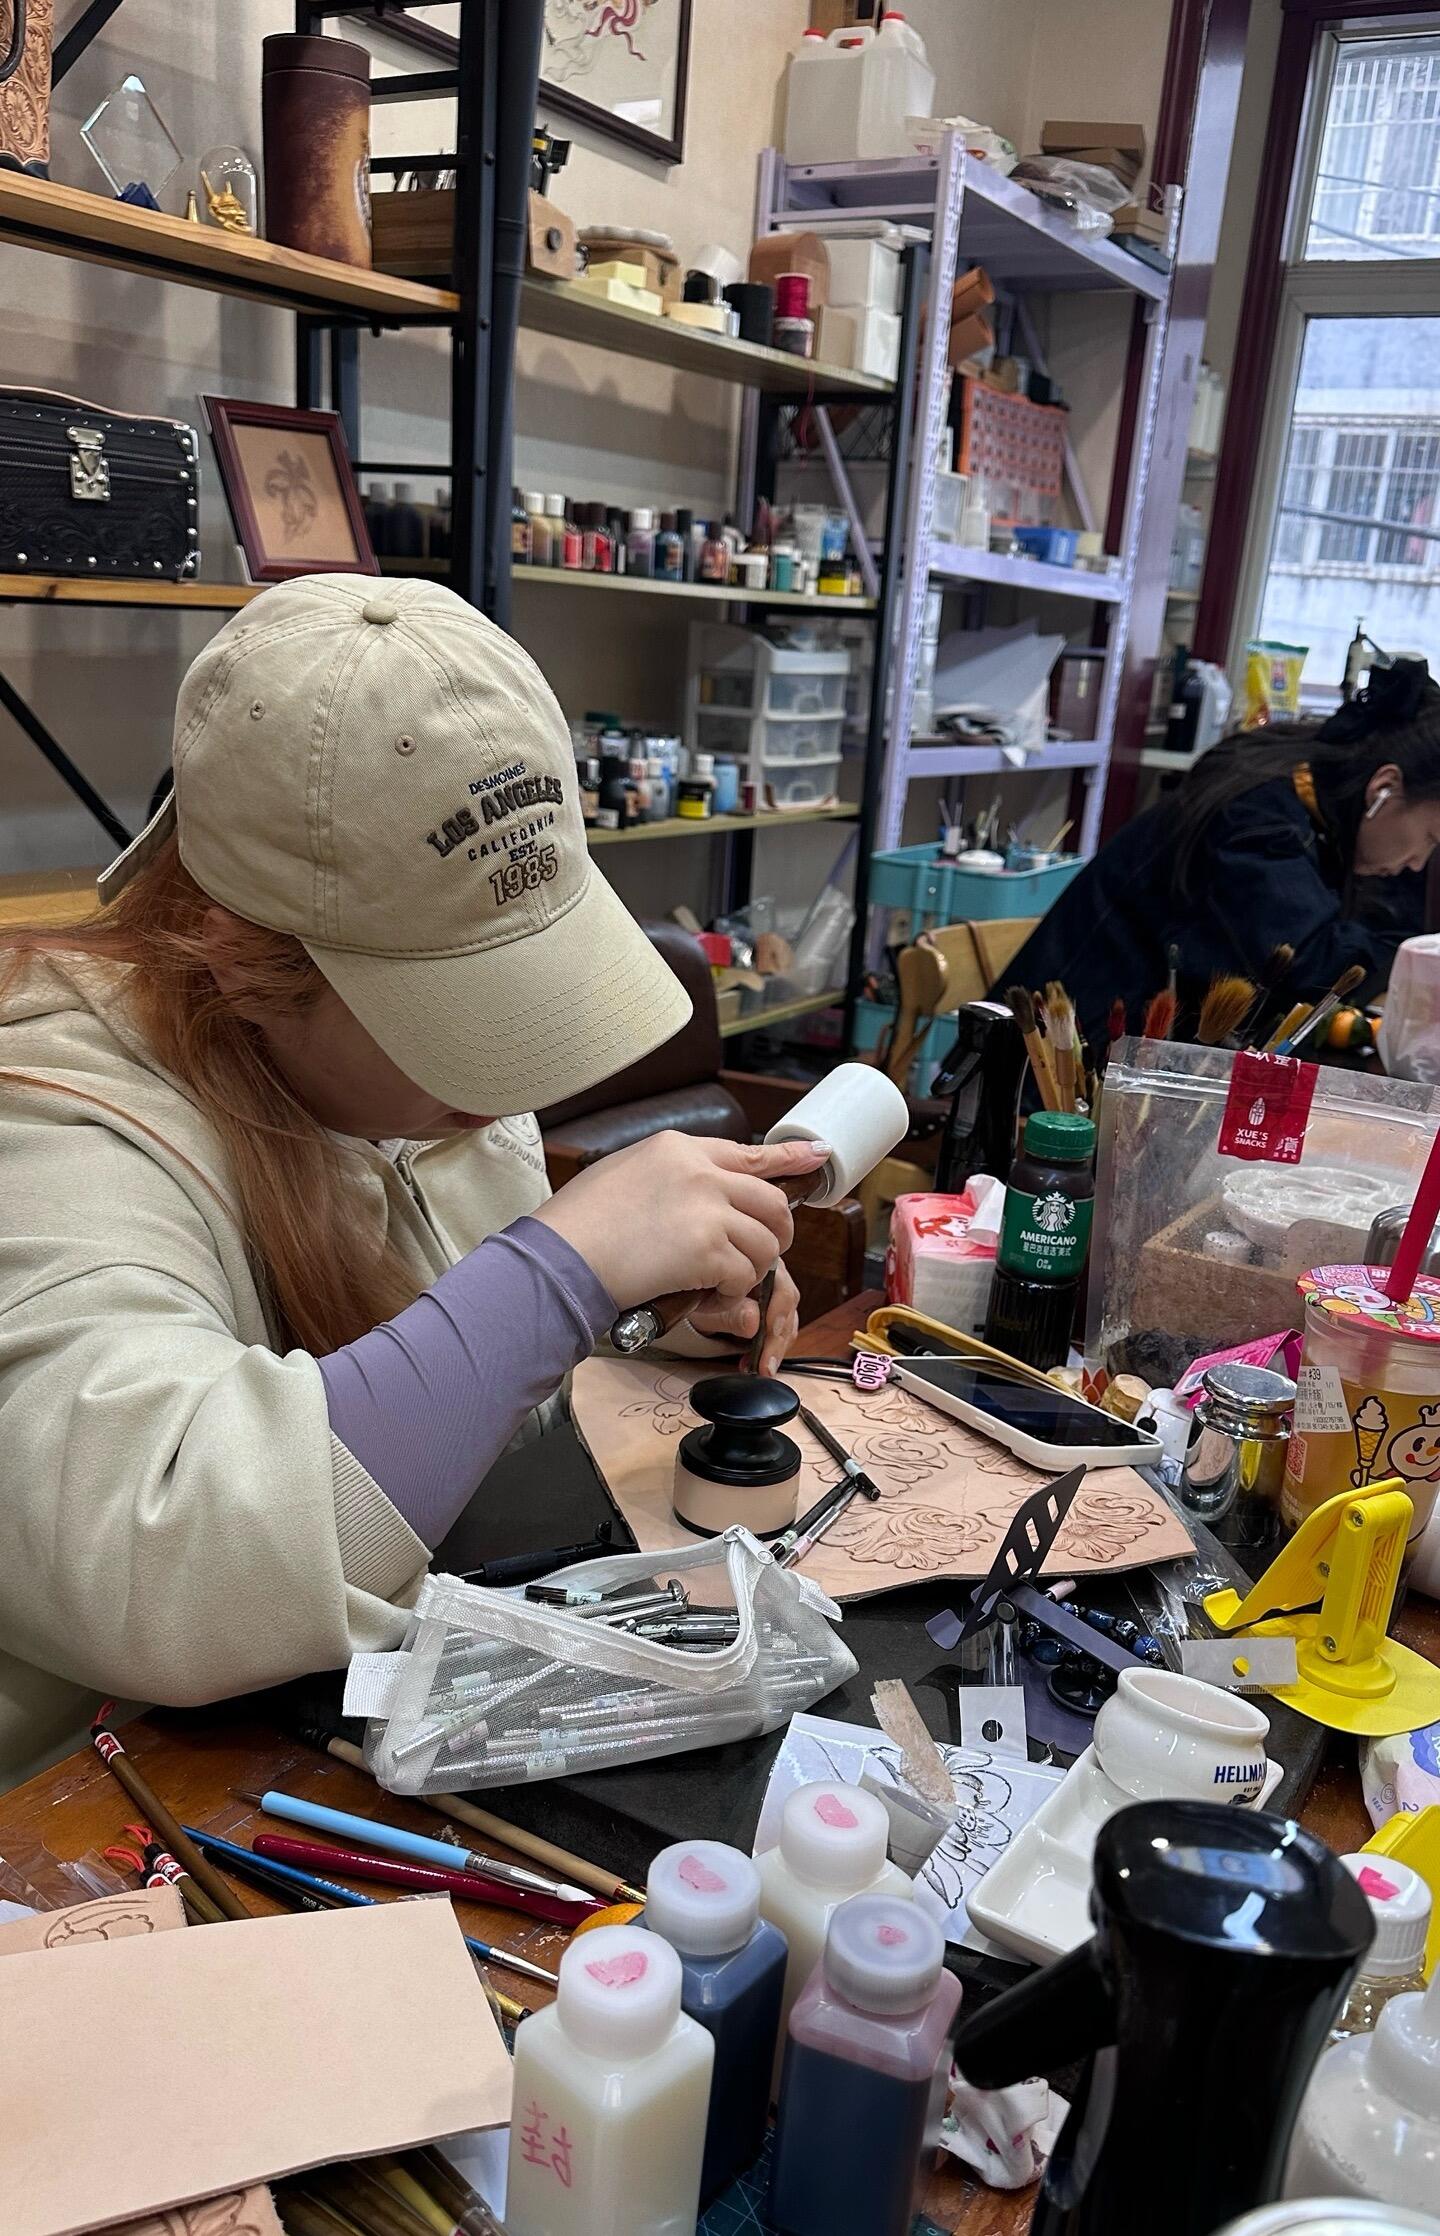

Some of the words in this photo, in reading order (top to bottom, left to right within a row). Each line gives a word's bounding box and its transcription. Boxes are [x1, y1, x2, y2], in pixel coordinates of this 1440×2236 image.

[427, 807, 480, 858] LOS
[480, 775, 564, 825] ANGELES
[467, 811, 555, 861] CALIFORNIA
[489, 844, 559, 906] 1985
[1234, 1137, 1267, 1149] SNACKS
[1236, 1128, 1269, 1140] XUE'S
[1020, 1230, 1077, 1246] AMERICANO
[1214, 1763, 1266, 1783] HELLMA
